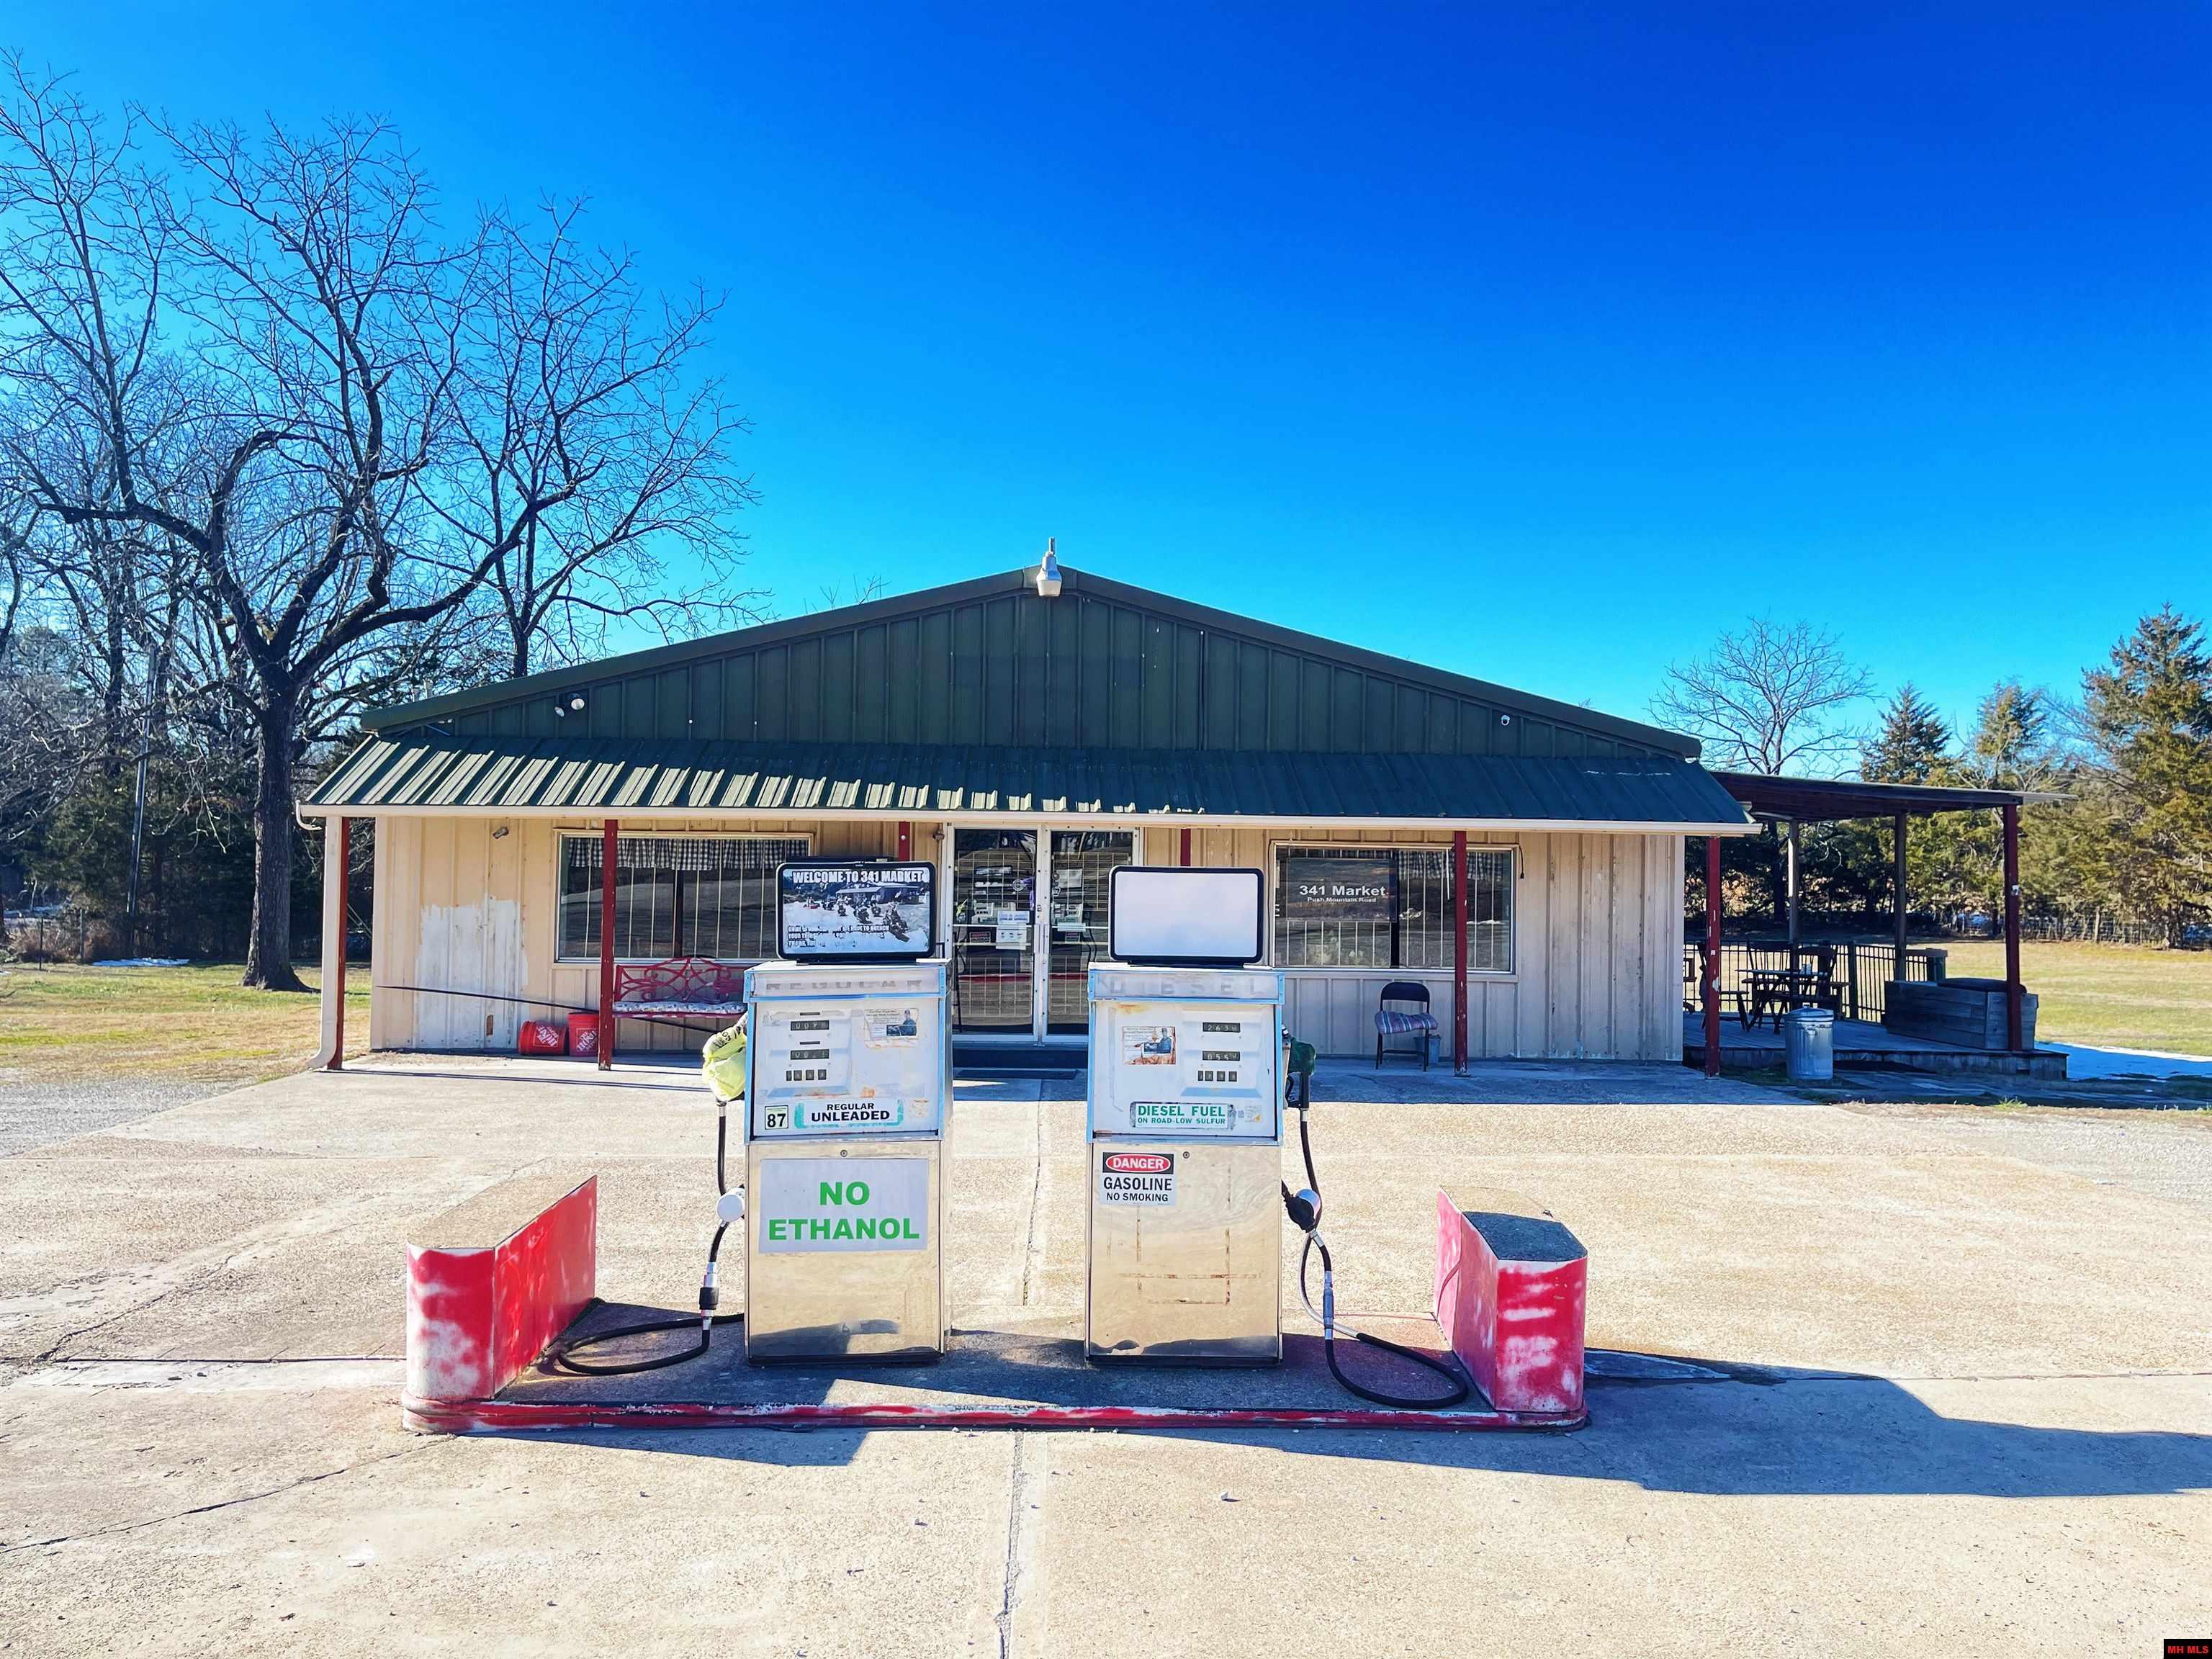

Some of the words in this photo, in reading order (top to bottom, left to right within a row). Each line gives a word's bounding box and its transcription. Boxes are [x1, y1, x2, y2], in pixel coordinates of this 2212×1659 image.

[793, 871, 843, 883] WELCOME
[846, 871, 859, 883] TO
[860, 871, 879, 883] 341
[881, 870, 923, 883] MARKET
[1299, 885, 1325, 895] 341
[1332, 885, 1386, 896] Market
[811, 1110, 890, 1122] UNLEADED
[1138, 1105, 1184, 1116] DIESEL
[1192, 1106, 1226, 1117] FUEL
[767, 1113, 786, 1128] 87
[1112, 1157, 1164, 1169] DANGER
[1103, 1177, 1172, 1190] GASOLINE
[819, 1182, 870, 1205] NO
[1107, 1192, 1120, 1201] NO
[1123, 1192, 1168, 1202] SMOKING
[769, 1218, 920, 1240] ETHANOL
